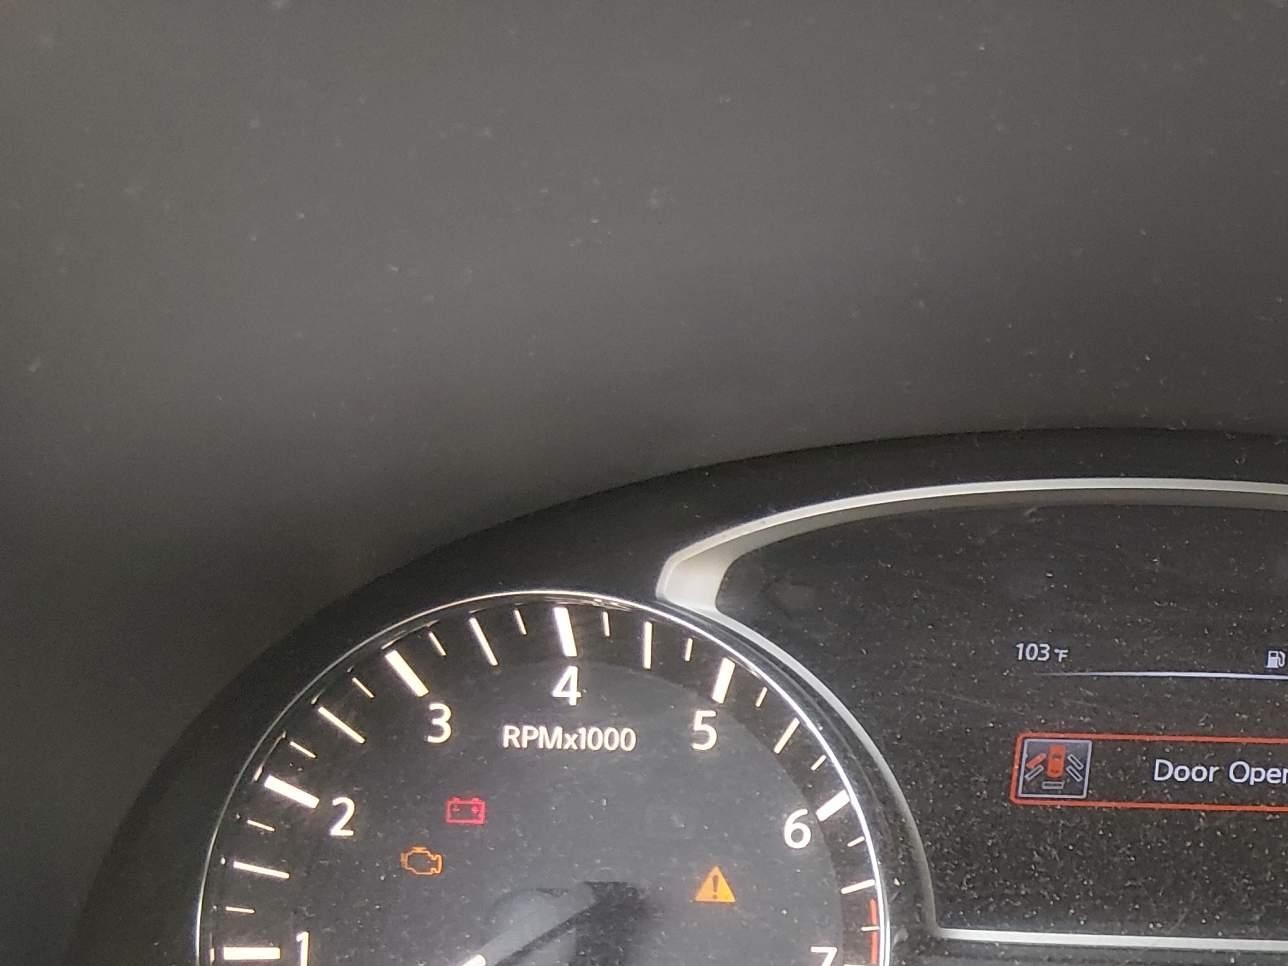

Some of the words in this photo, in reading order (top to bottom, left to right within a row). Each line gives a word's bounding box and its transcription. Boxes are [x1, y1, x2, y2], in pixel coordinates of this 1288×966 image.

[1016, 643, 1050, 661] 103
[551, 665, 582, 706] 4
[427, 702, 452, 744] 3
[502, 725, 637, 752] RPMx1000
[691, 709, 718, 751] 5
[1153, 759, 1220, 782] Door
[330, 797, 355, 837] 2
[783, 808, 812, 849] 6
